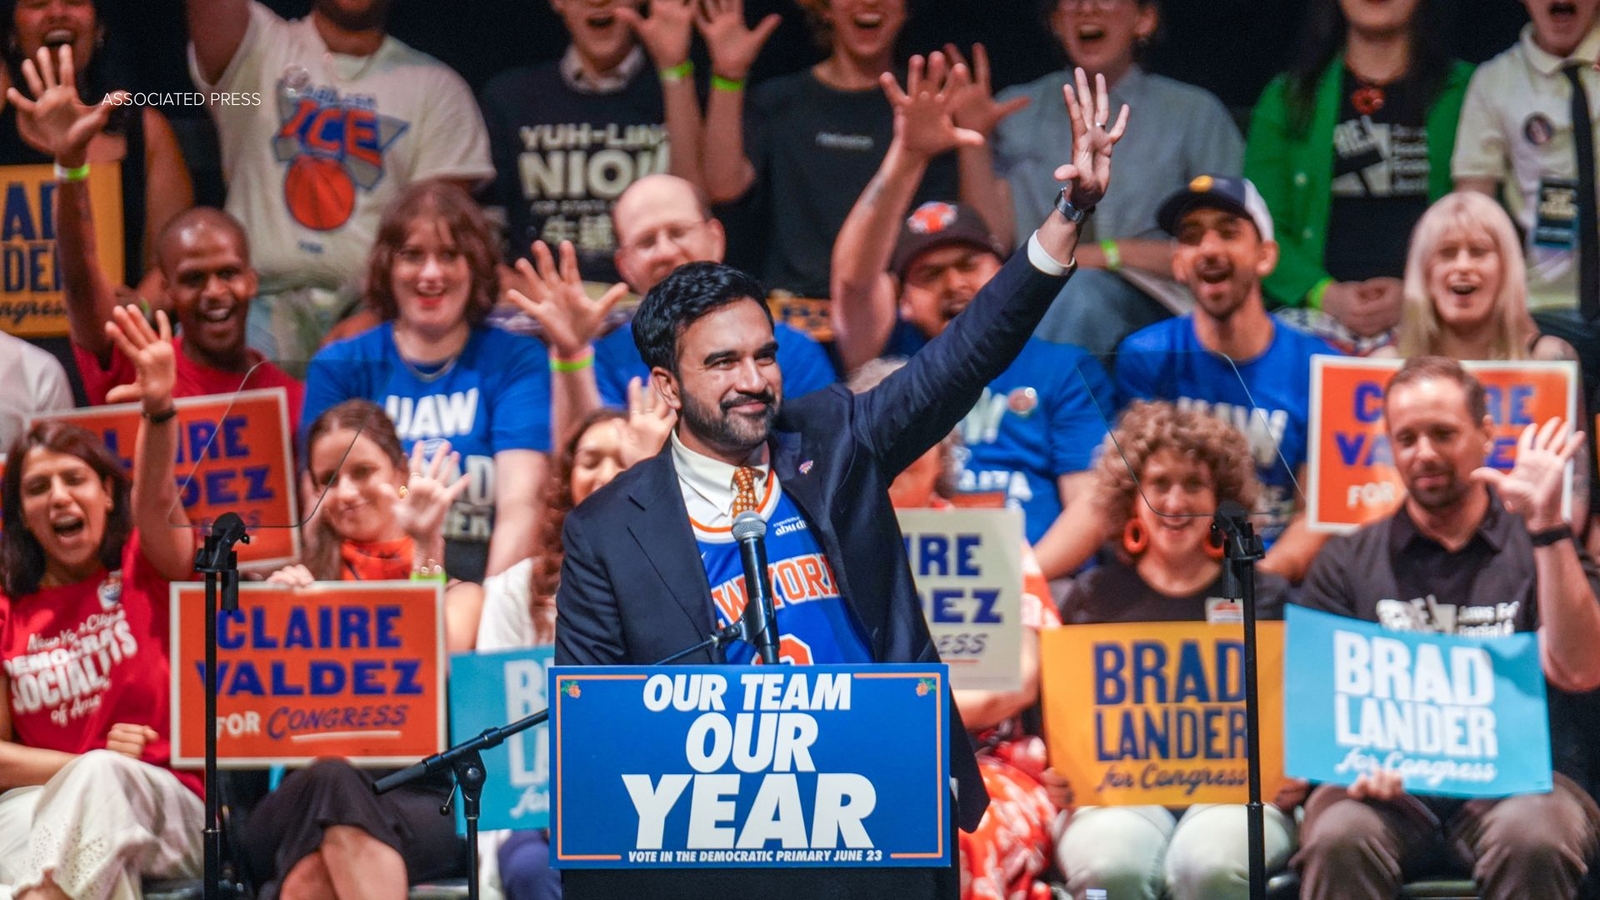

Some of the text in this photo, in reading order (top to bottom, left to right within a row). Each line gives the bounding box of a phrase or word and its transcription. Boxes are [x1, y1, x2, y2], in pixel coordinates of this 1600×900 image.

[280, 98, 384, 168] ICE
[216, 606, 403, 651] CLAIRE
[195, 660, 424, 697] VALDEZ
[643, 673, 851, 712] OUR TEAM
[1094, 639, 1247, 705] BRAD
[1333, 629, 1496, 706] BRAD
[266, 704, 409, 740] CONGRESS
[685, 712, 819, 774] OUR
[1096, 706, 1249, 762] LANDER
[1335, 692, 1499, 759] LANDER
[620, 773, 877, 850] YEAR
[628, 850, 883, 863] VOTE IN THE DEMOCRATIC PRIMARY JUNE 23
